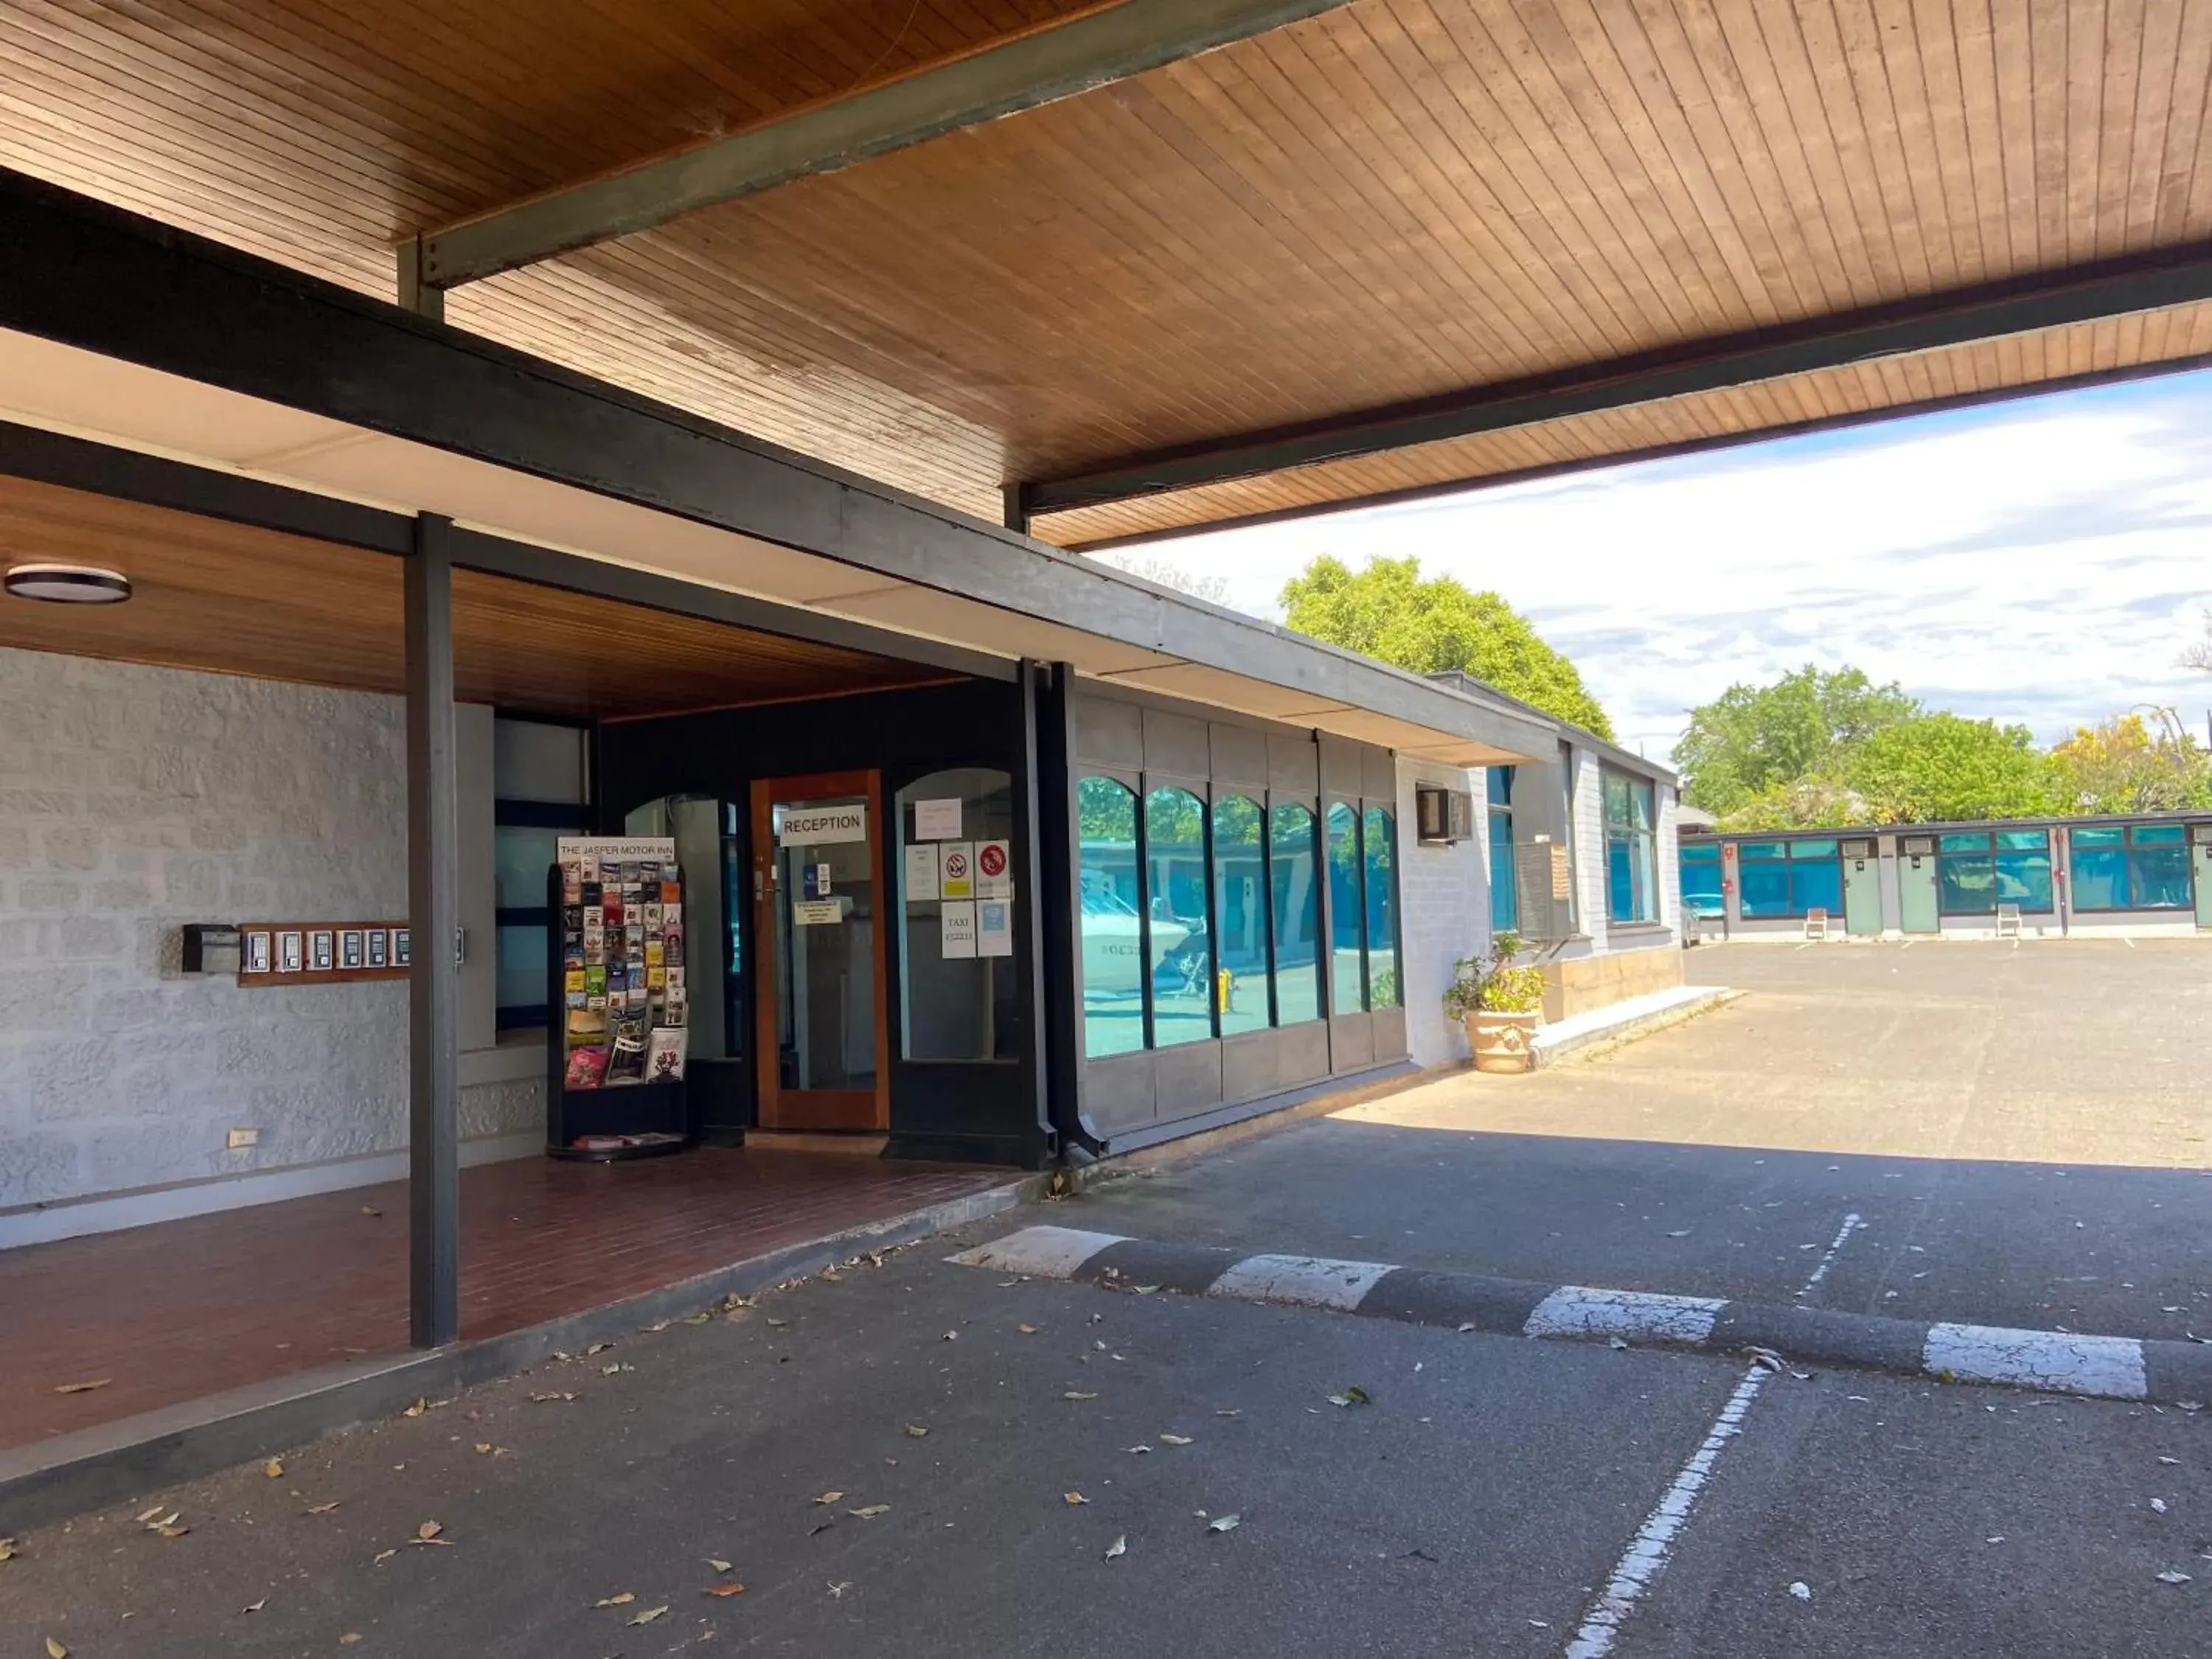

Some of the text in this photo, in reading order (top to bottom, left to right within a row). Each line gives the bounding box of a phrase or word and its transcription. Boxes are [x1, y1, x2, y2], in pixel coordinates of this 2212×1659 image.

[784, 815, 860, 834] RECEPTION
[560, 846, 673, 855] THE JASPER MOTOR INN
[948, 918, 969, 927] TAXI
